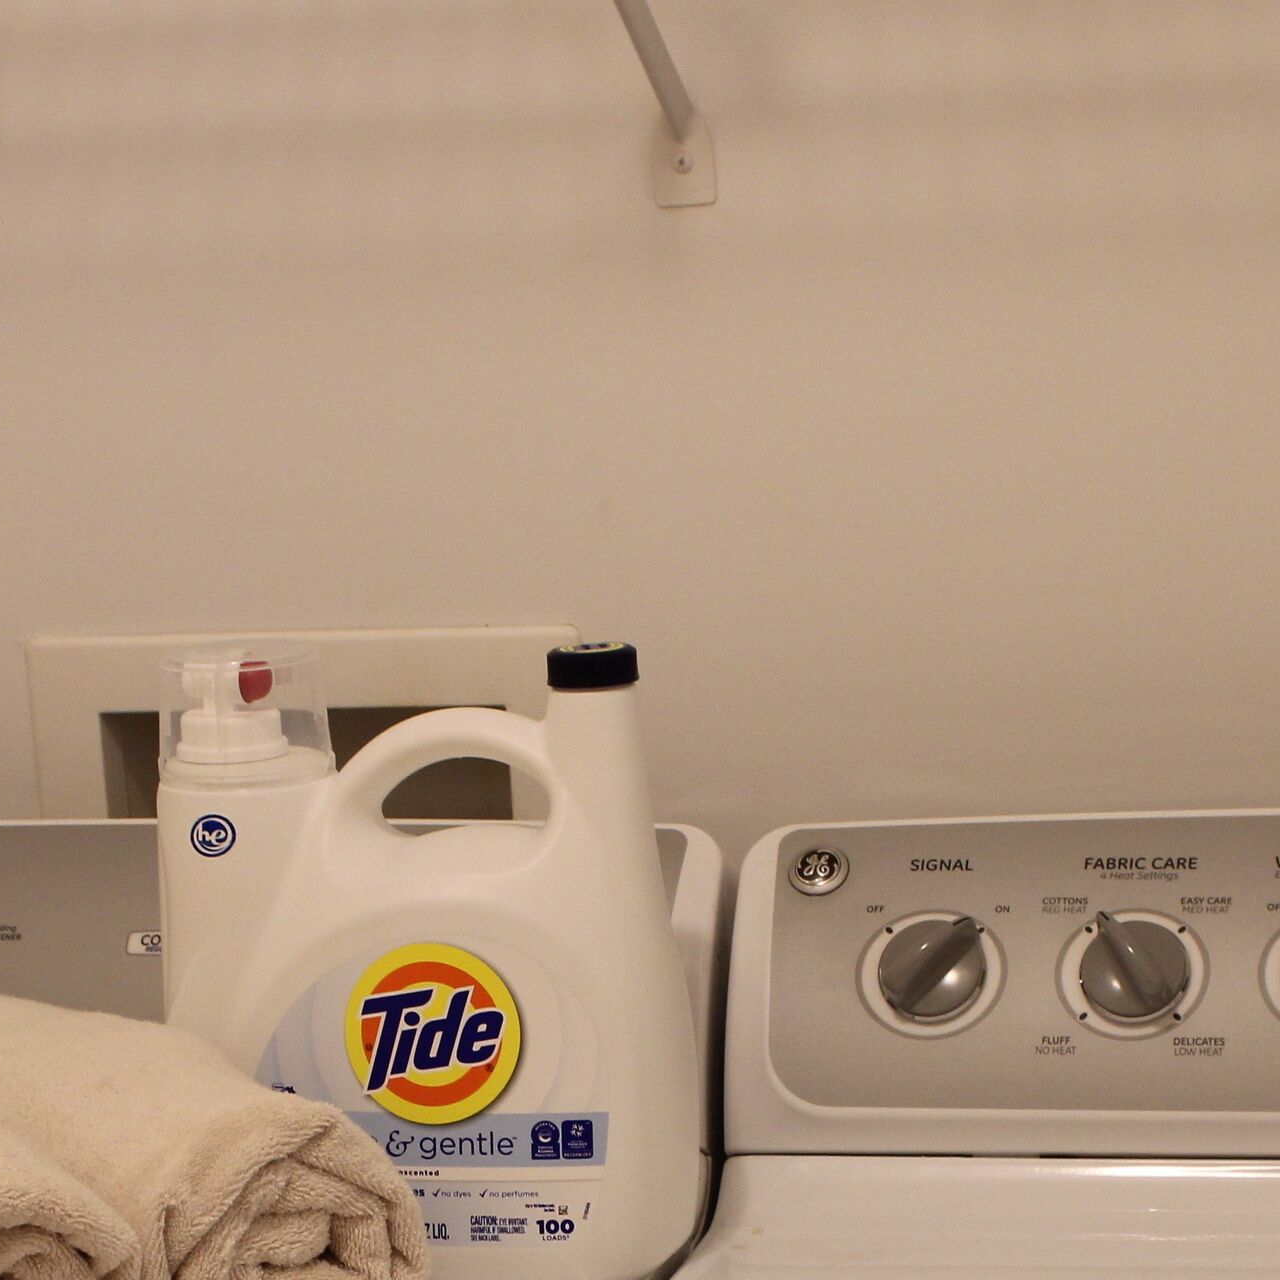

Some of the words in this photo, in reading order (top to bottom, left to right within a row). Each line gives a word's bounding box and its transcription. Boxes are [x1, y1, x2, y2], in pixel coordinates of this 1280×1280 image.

[194, 819, 231, 850] he
[910, 859, 973, 872] SIGNAL
[1084, 857, 1146, 870] FABRIC
[1151, 857, 1199, 870] CARE
[1099, 872, 1106, 880] 4
[1109, 871, 1135, 880] Heat
[1137, 871, 1179, 882] Settings
[1042, 897, 1089, 905] COTTONS
[1180, 896, 1205, 905] EASY
[1206, 896, 1232, 905] CARE
[866, 905, 885, 913] OFF
[995, 905, 1011, 913] ON
[1042, 905, 1062, 914] REG
[1063, 905, 1088, 914] HEAT
[1182, 905, 1204, 914] MED
[1206, 905, 1230, 914] HEAT
[140, 934, 162, 946] CO
[360, 987, 505, 1093] Tide
[1041, 1036, 1071, 1045] FLUFF
[1173, 1037, 1225, 1046] DELICATES
[1035, 1046, 1051, 1055] NO
[1052, 1046, 1077, 1056] HEAT
[1174, 1047, 1197, 1056] LOW
[1199, 1047, 1223, 1057] HEAT
[386, 1130, 415, 1157] &
[419, 1131, 515, 1159] gentle
[398, 1169, 440, 1177] nscented
[453, 1189, 472, 1199] dyes
[501, 1189, 539, 1199] perfumes
[470, 1215, 499, 1226] CAUTION:
[432, 1223, 450, 1241] LIQ.
[536, 1219, 575, 1235] 100
